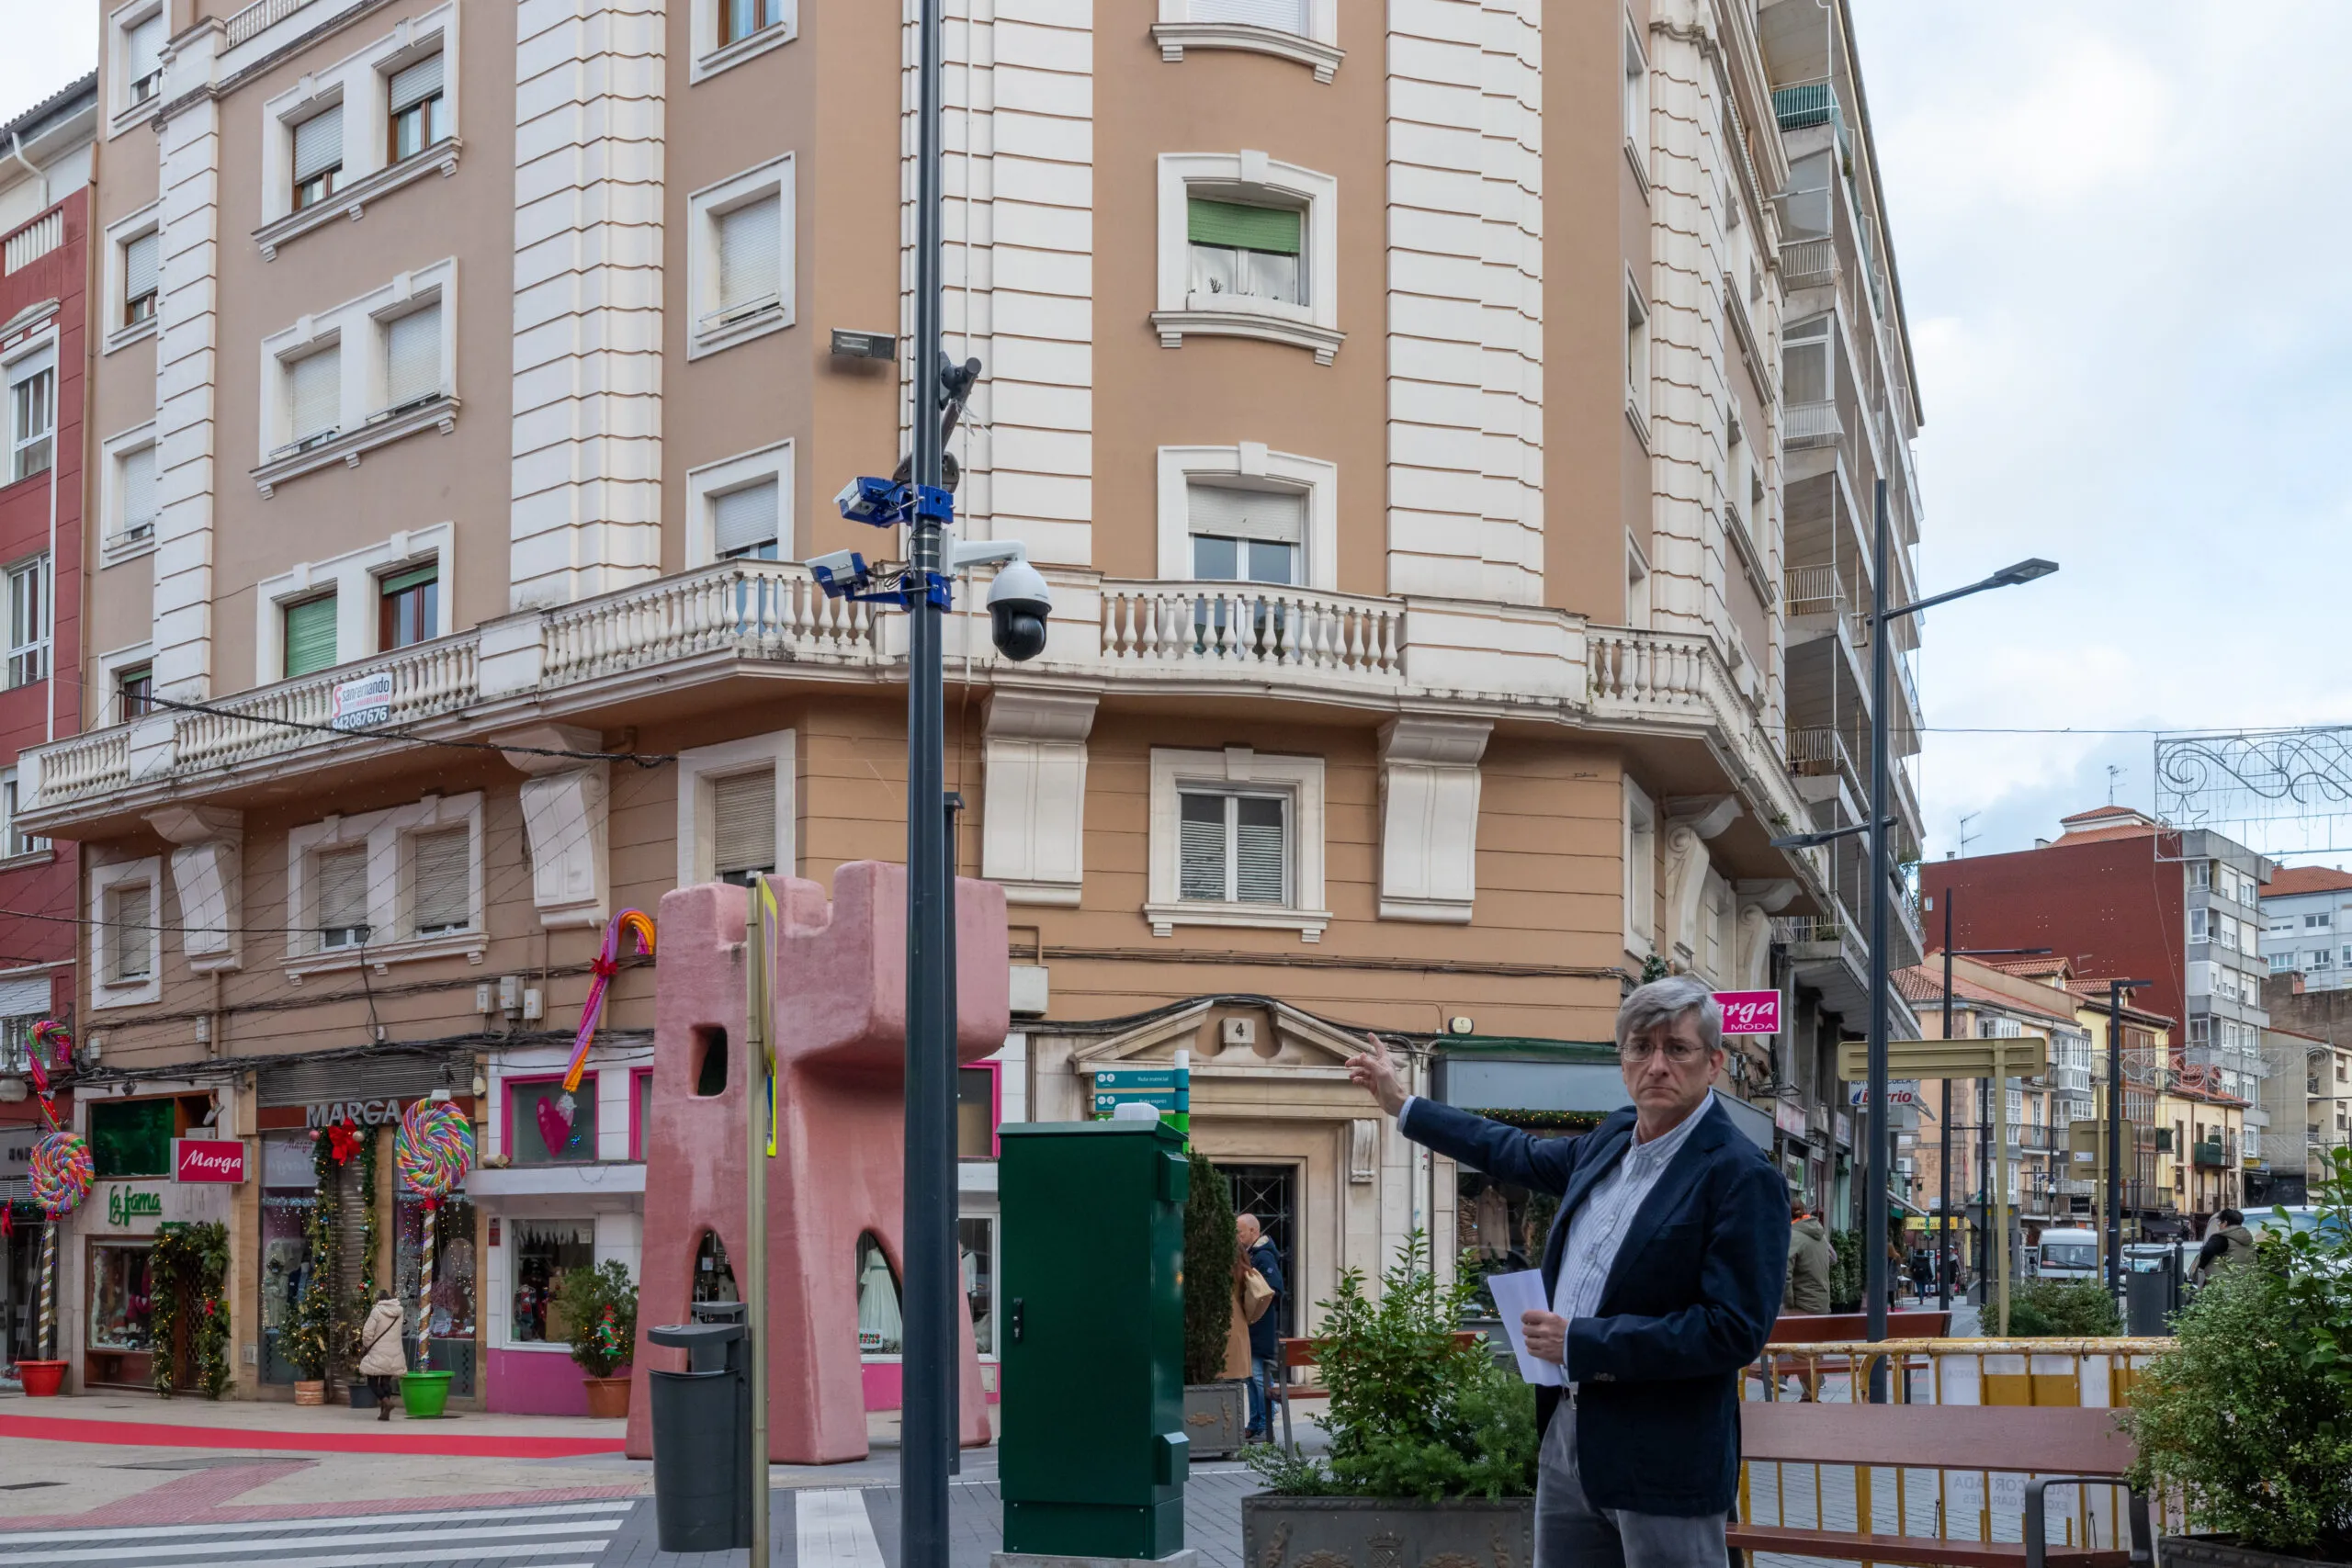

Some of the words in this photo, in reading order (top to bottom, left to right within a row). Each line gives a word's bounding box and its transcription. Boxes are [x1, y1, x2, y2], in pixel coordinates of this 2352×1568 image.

[1235, 1022, 1245, 1037] 4
[1731, 1022, 1775, 1031] MODA
[306, 1099, 402, 1128] MARGA
[180, 1148, 243, 1174] Marga
